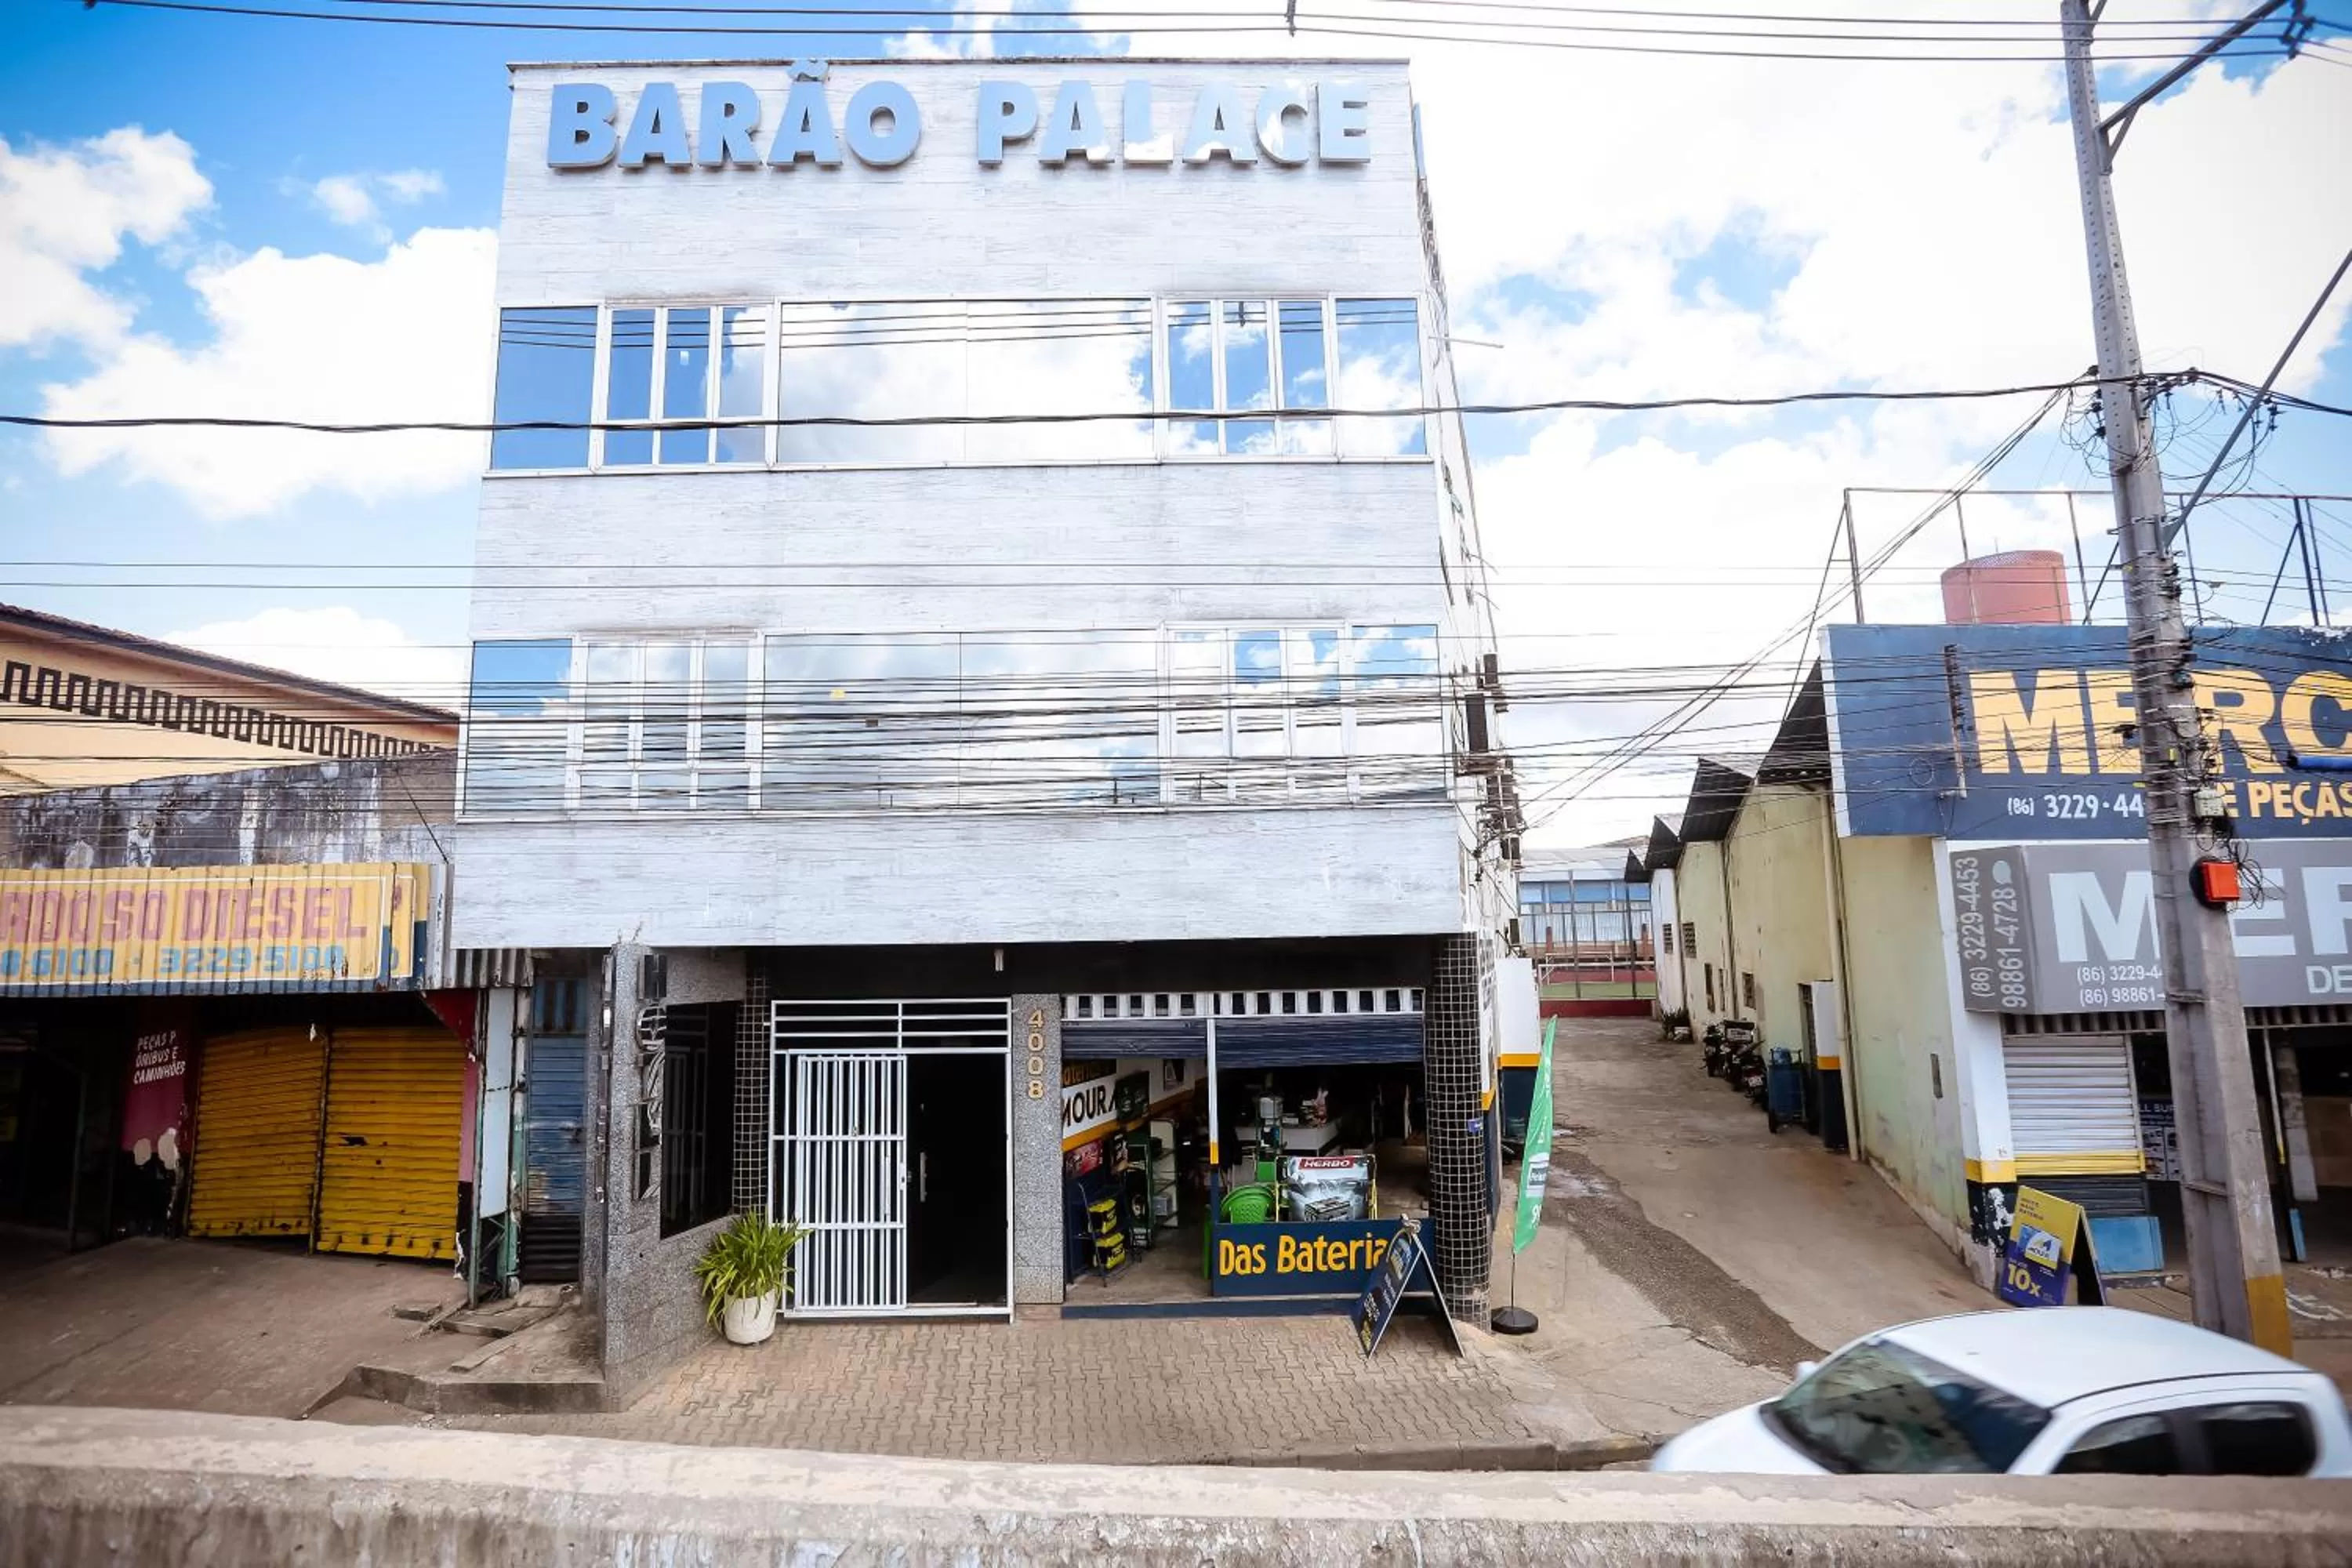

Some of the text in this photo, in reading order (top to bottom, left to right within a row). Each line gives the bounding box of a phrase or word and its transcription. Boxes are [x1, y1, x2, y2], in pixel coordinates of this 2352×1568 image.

[546, 58, 1372, 169] BARÃO PALACE
[182, 887, 368, 942] DIESEL
[1955, 856, 1995, 998] (86) 3229-4453
[1991, 887, 2028, 1008] 98861-4728
[2077, 964, 2106, 986] (86)
[2080, 987, 2108, 1007] (86)
[1028, 1008, 1045, 1099] 4008
[1219, 1239, 1267, 1276] Das
